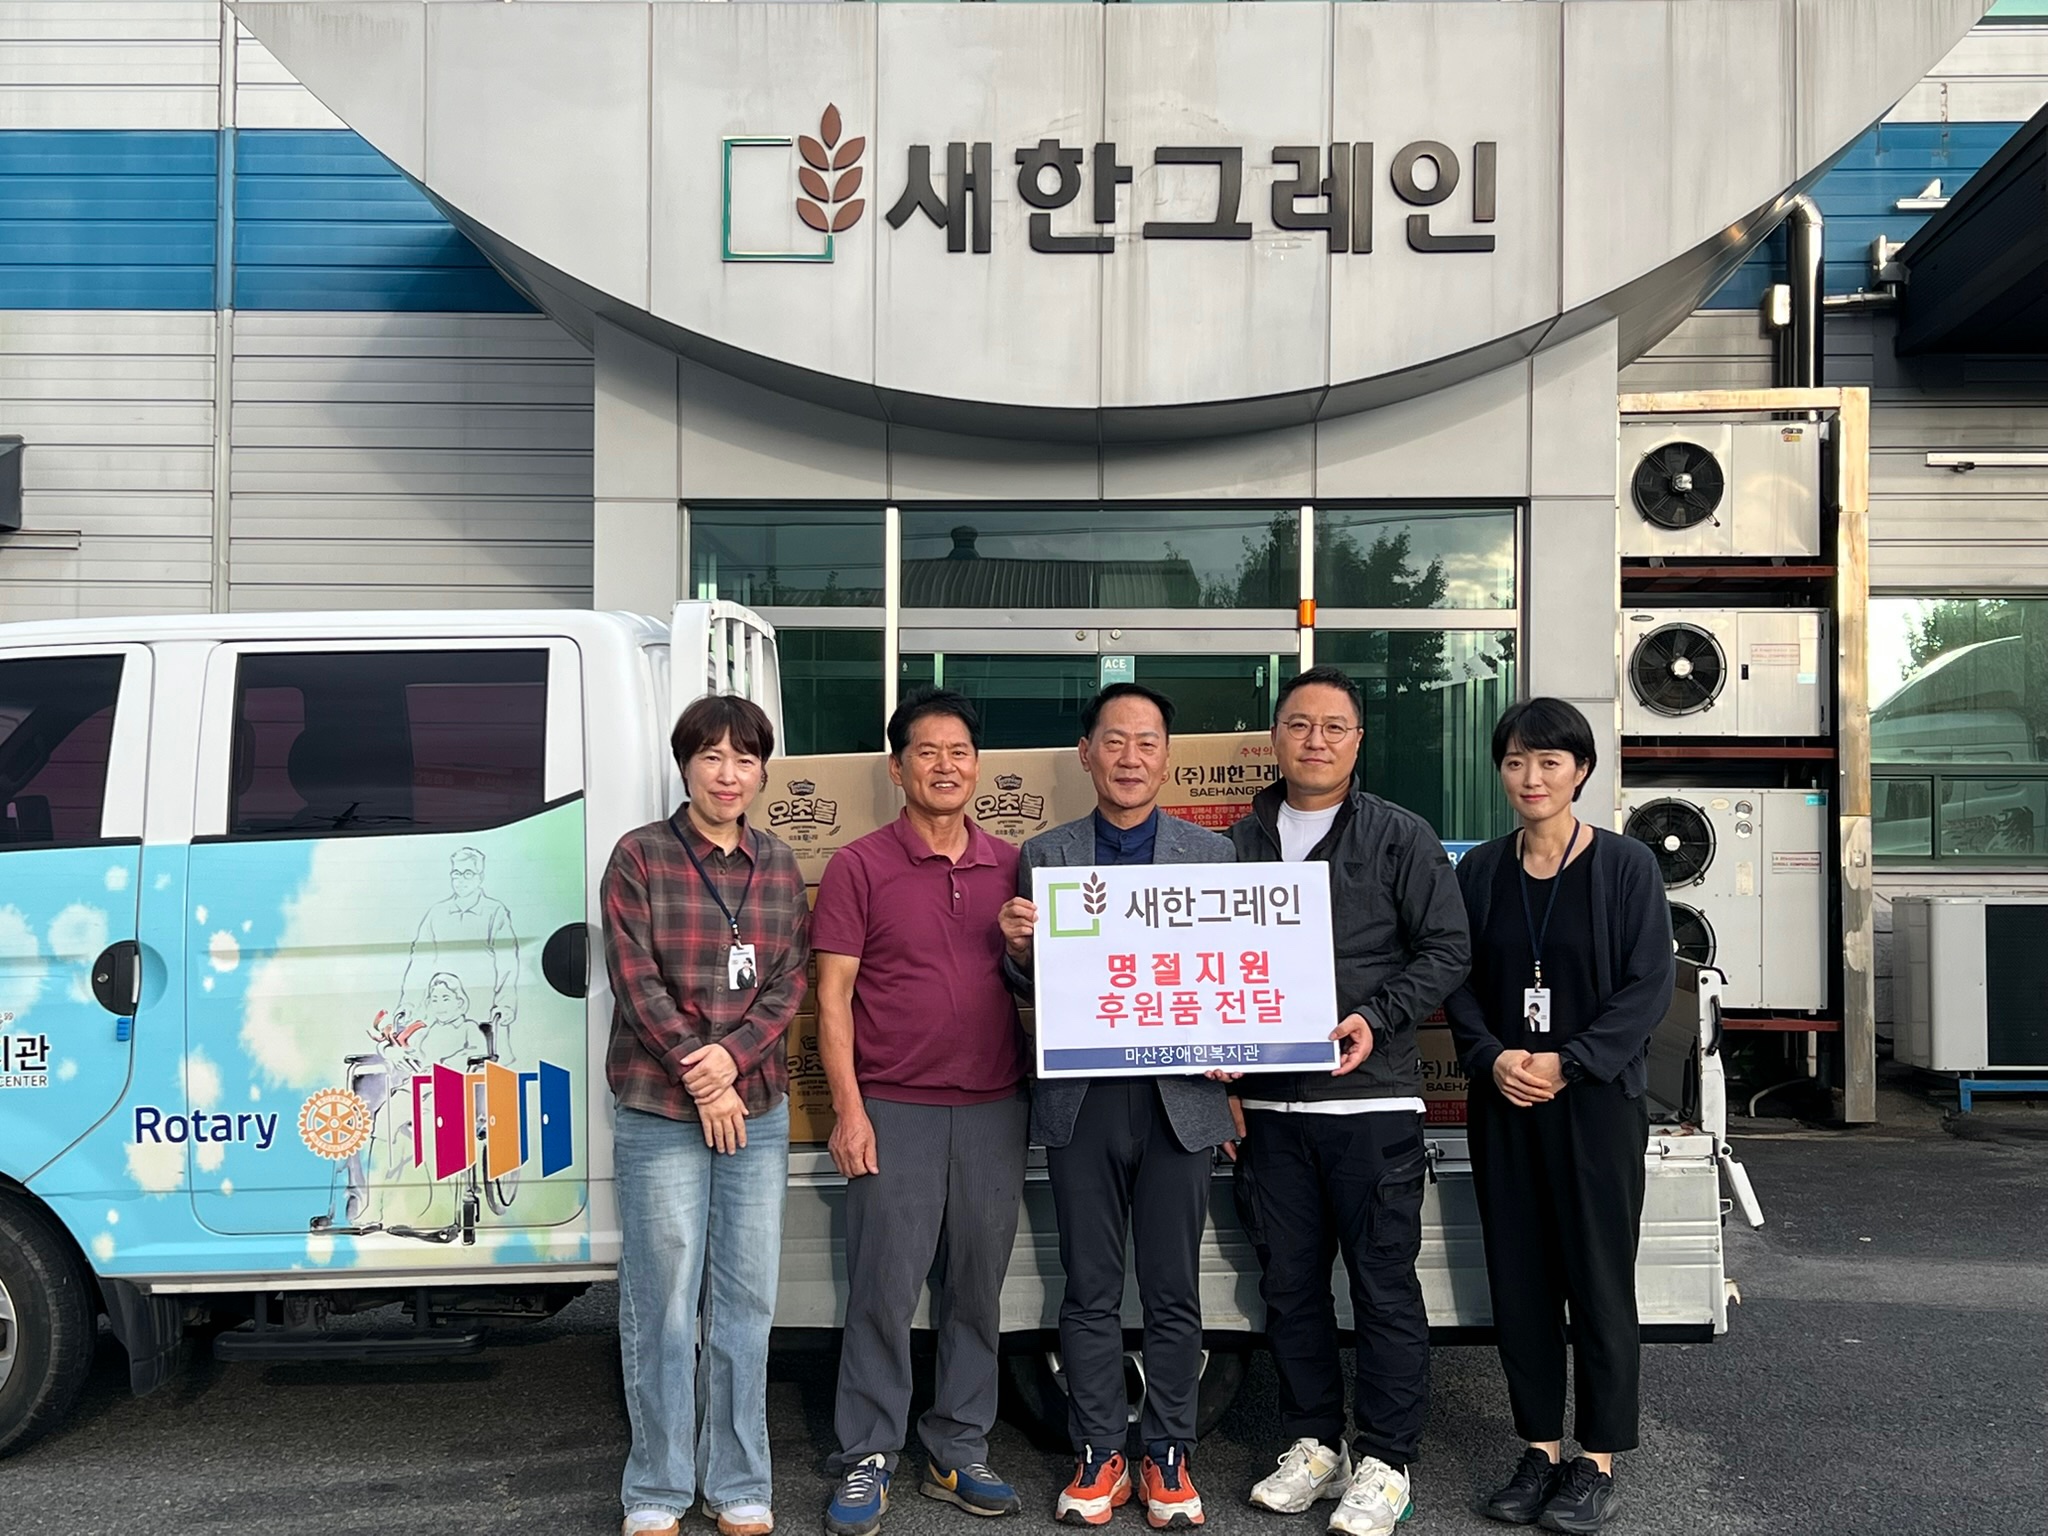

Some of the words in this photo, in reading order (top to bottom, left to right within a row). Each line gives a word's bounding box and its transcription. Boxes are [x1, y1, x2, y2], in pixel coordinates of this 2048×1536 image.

[885, 138, 1496, 254] 새한그레인
[1104, 658, 1127, 669] ACE
[1241, 746, 1273, 757] 추억의
[1174, 765, 1205, 786] (주)
[1124, 884, 1301, 929] 새한그레인
[1095, 991, 1202, 1029] 후원품
[1214, 988, 1286, 1025] 전달
[1125, 1044, 1261, 1066] 마산장애인복지관
[135, 1107, 278, 1149] Rotary
